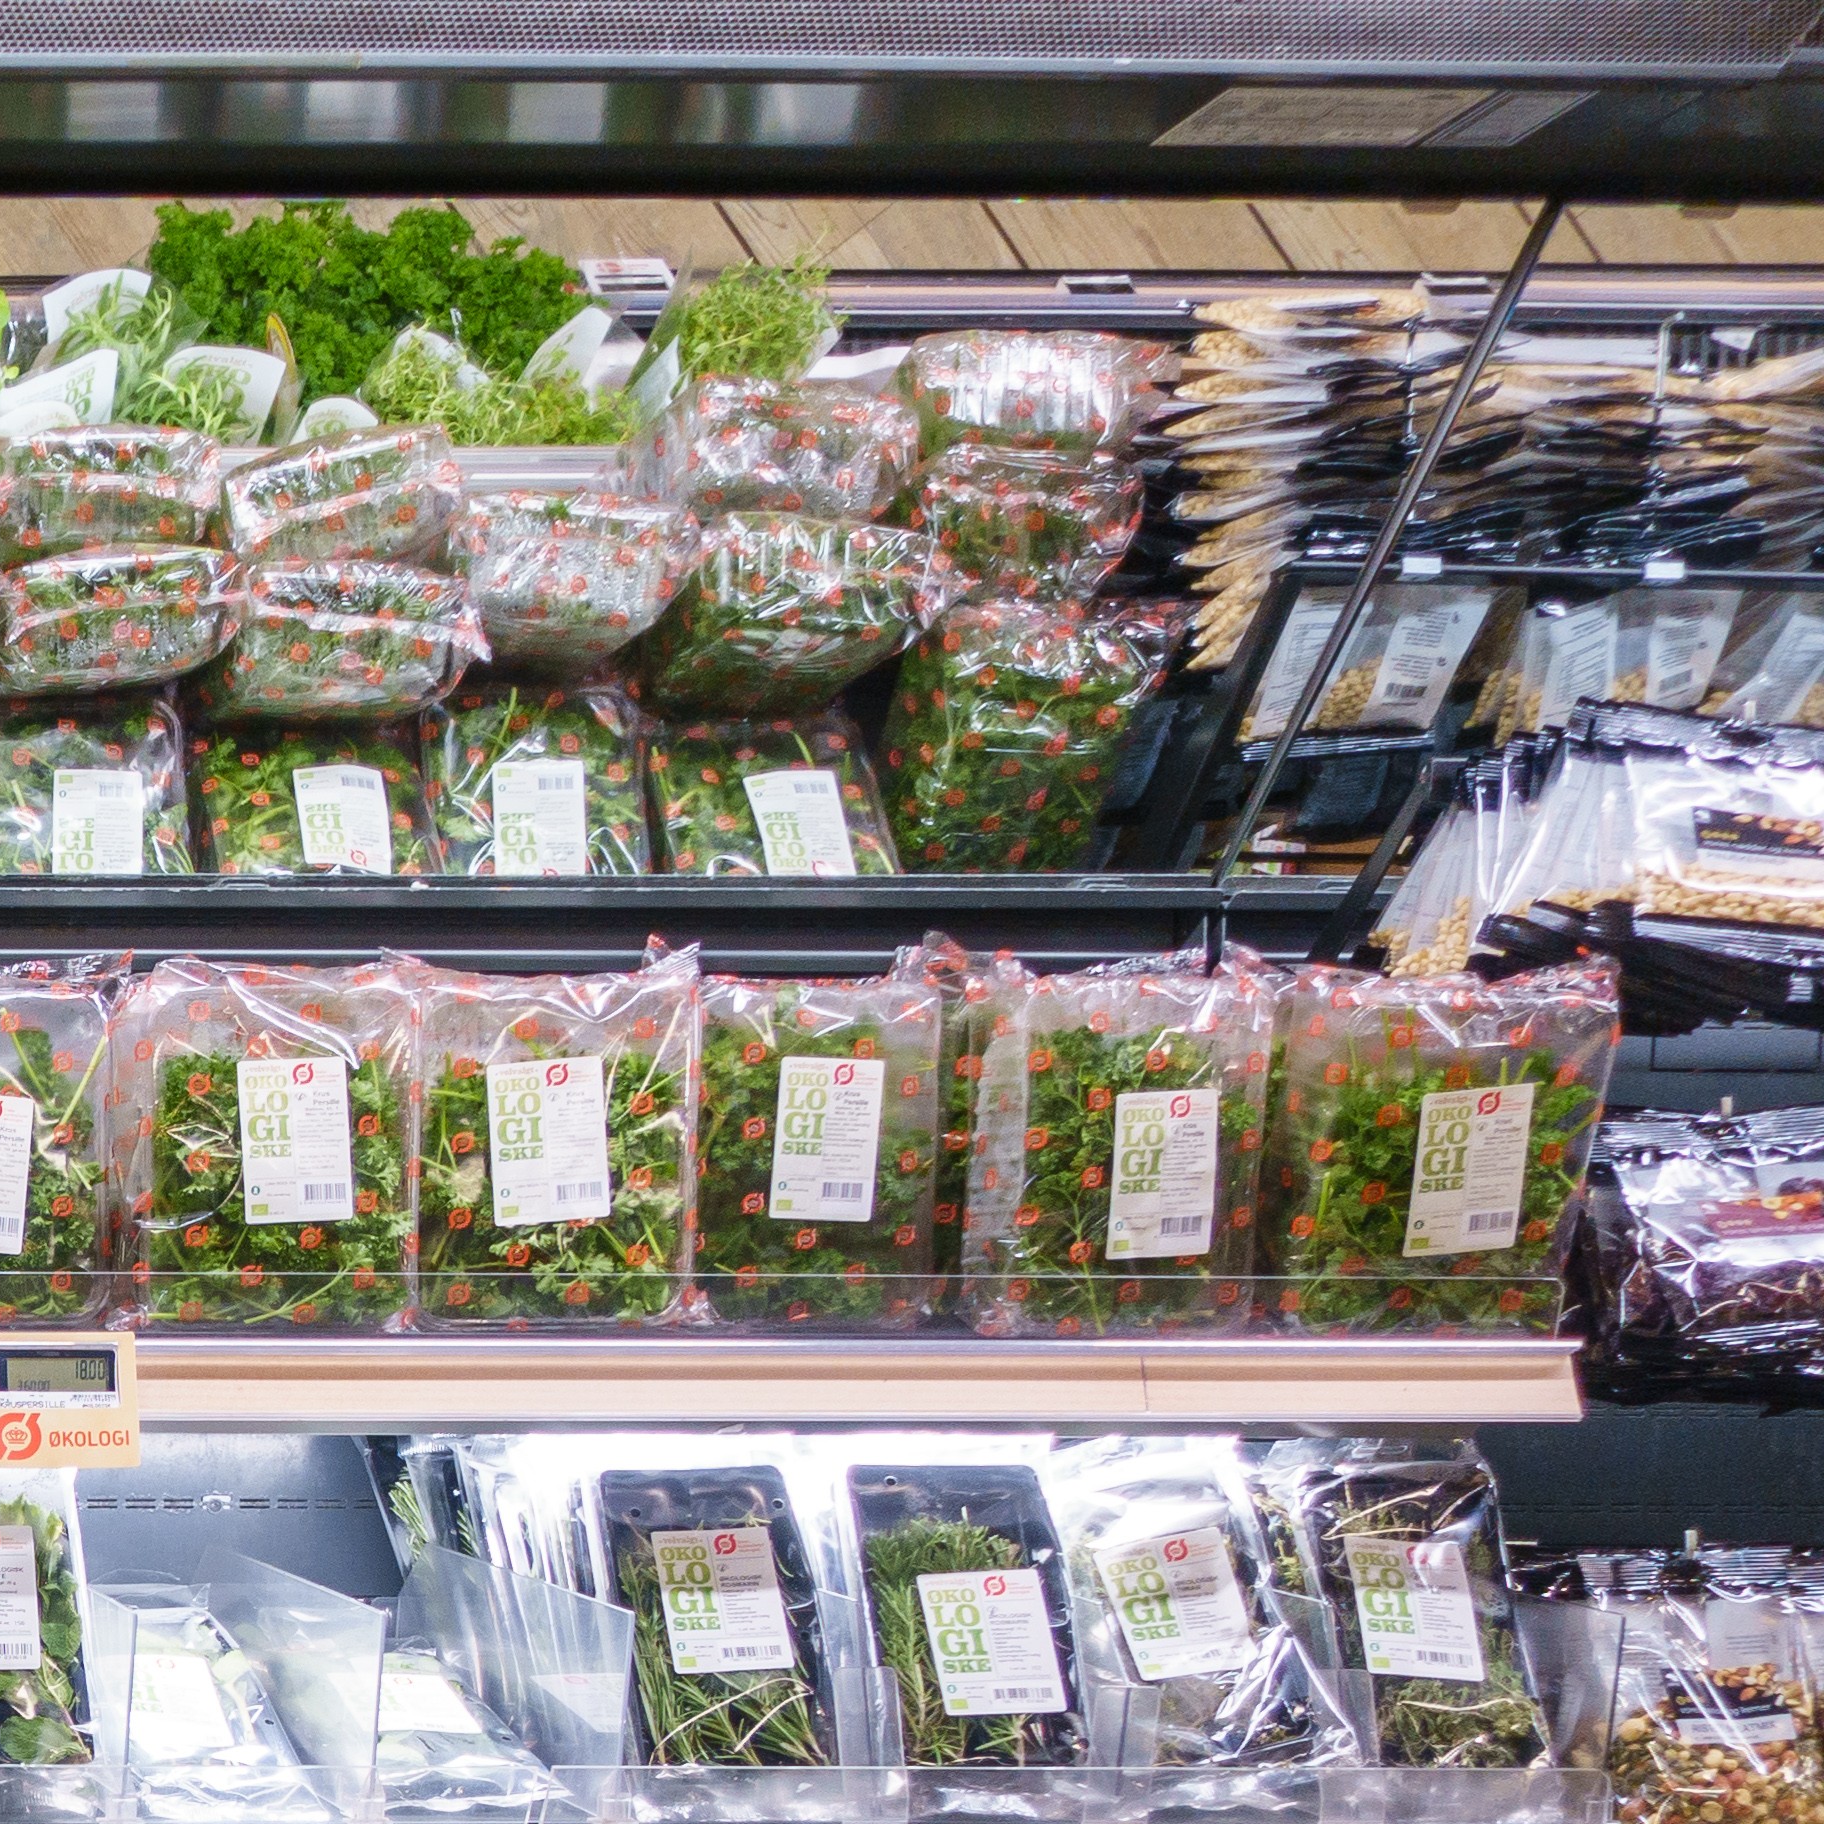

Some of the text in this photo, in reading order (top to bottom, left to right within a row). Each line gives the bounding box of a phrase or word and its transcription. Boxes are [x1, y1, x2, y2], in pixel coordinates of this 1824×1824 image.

[1427, 1105, 1472, 1124] ØKO
[1425, 1121, 1470, 1148] LO
[1422, 1145, 1468, 1176] GI
[1419, 1174, 1465, 1192] SKE
[73, 1360, 106, 1380] 18.00
[0, 1400, 66, 1409] KRUSPERSILLE
[48, 1429, 131, 1448] ØKOLOGI
[659, 1544, 707, 1564] ØKO
[662, 1561, 711, 1586] LO
[667, 1584, 719, 1615] GI
[672, 1613, 721, 1632] SKE
